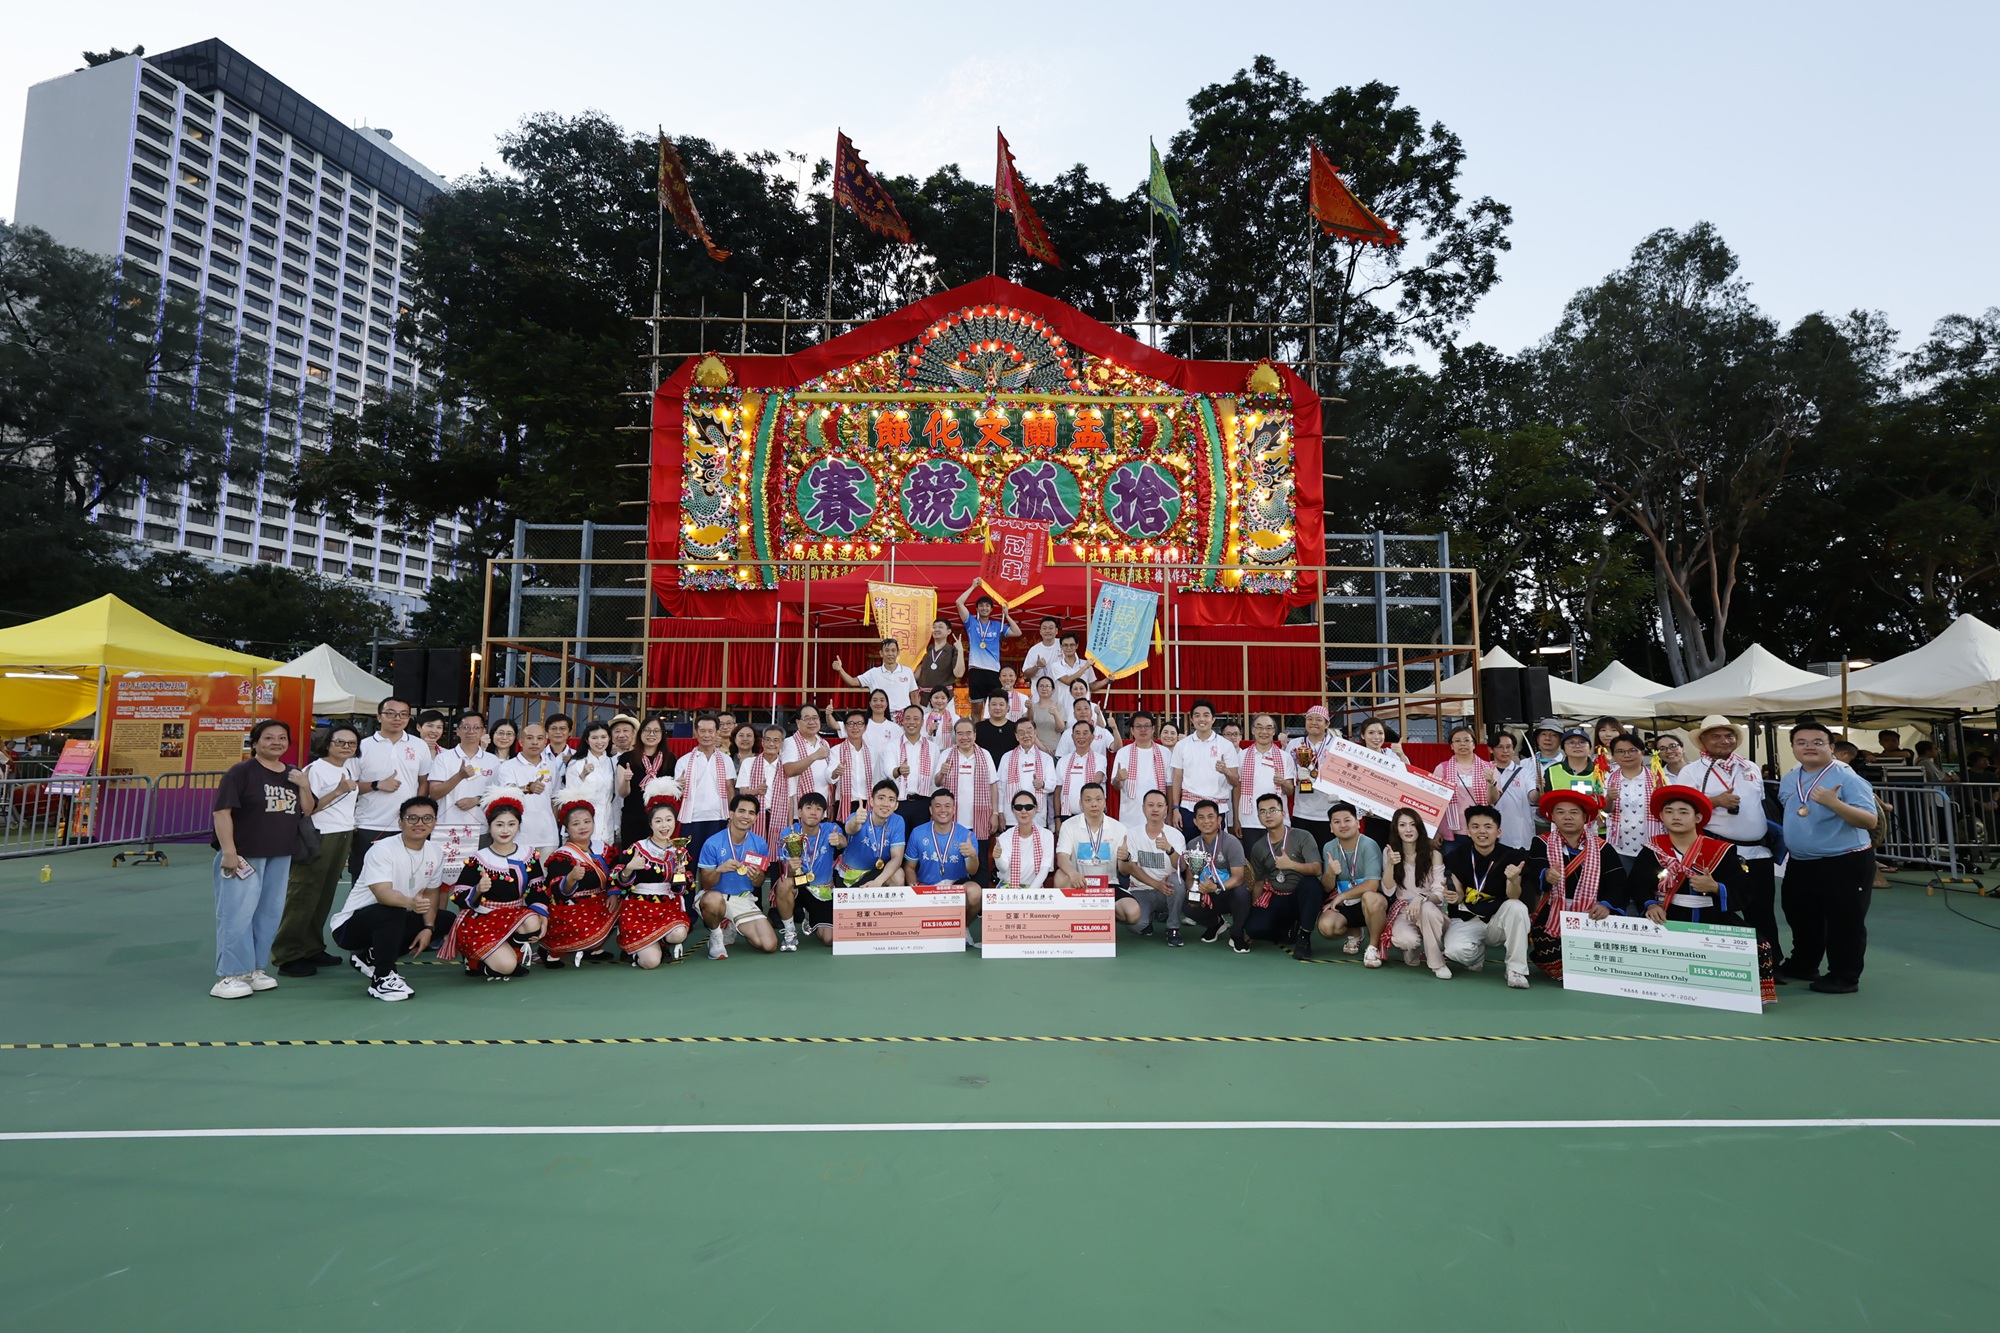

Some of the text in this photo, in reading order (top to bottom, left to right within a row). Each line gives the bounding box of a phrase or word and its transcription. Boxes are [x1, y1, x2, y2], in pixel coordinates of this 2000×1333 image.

[847, 162, 886, 211] 國泰民安
[873, 408, 1108, 449] 盂蘭文化節
[806, 460, 1180, 534] 搶孤競賽
[1001, 535, 1026, 581] 冠軍
[1593, 941, 1638, 952] 最佳隊形獎
[1642, 946, 1659, 954] Best
[1661, 949, 1706, 959] Formation
[1609, 967, 1642, 976] Thousand
[1644, 971, 1670, 980] Dollars
[1671, 974, 1688, 982] Only
[1693, 967, 1747, 979] HK$1,000.00
